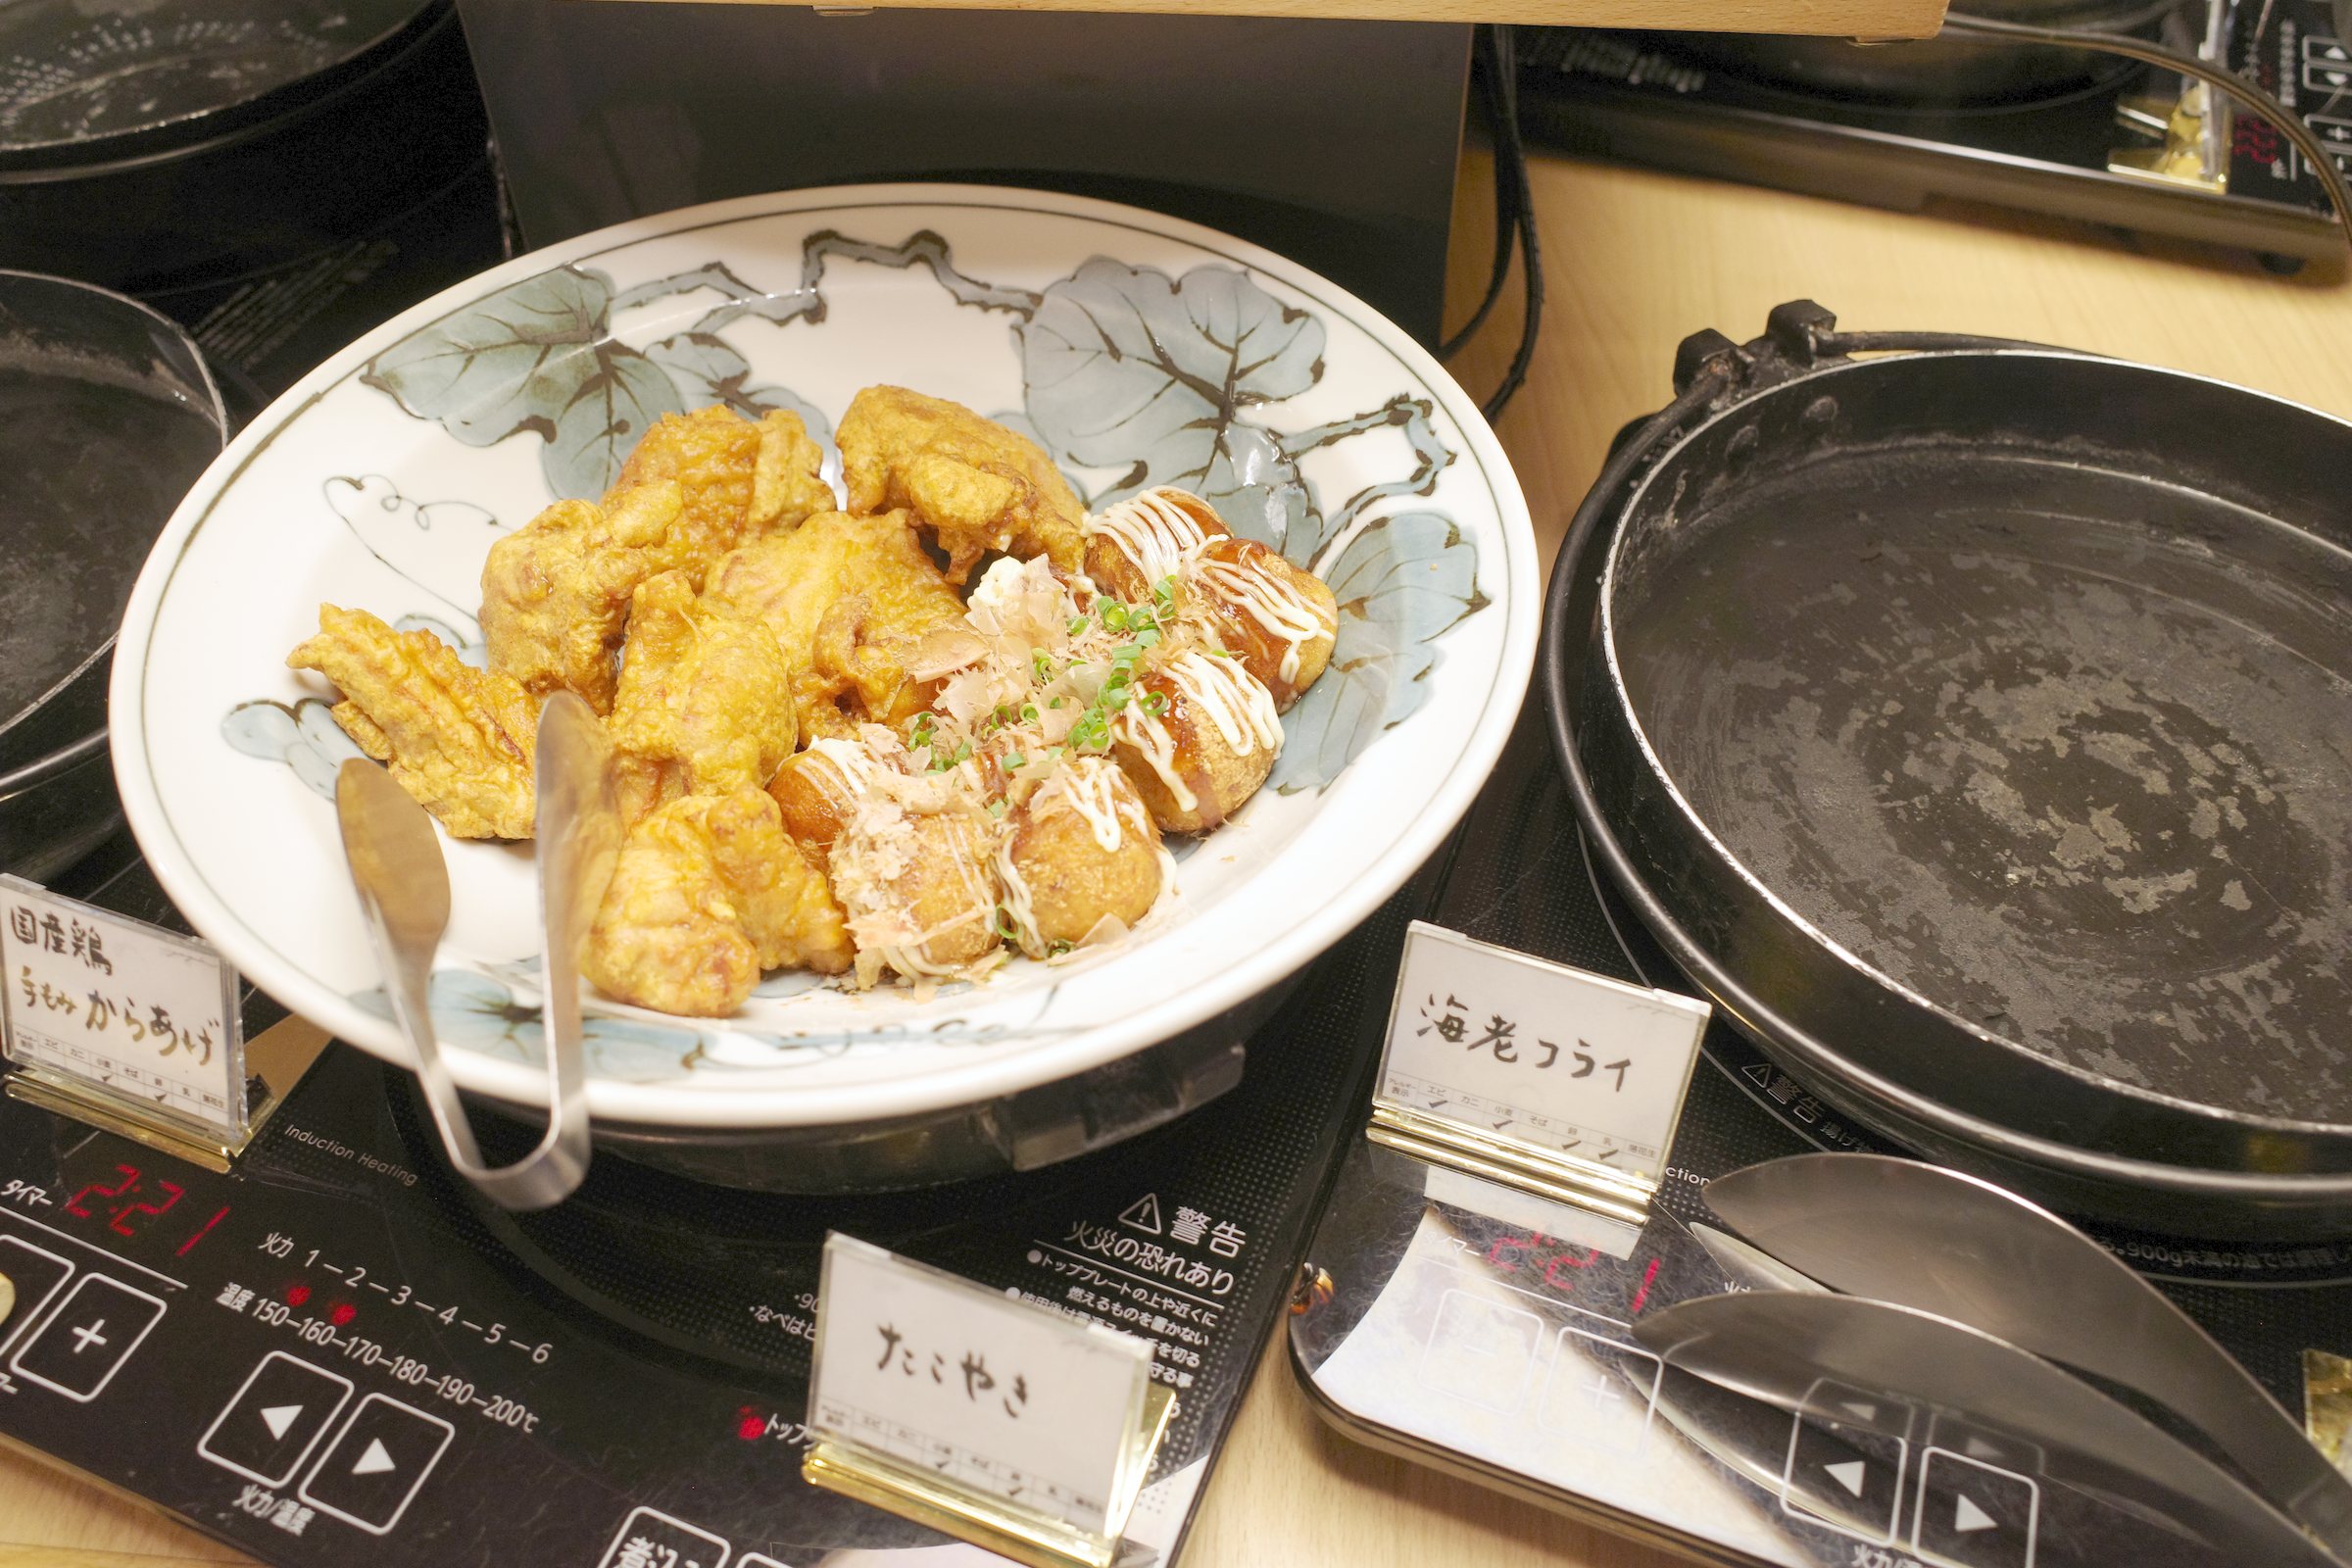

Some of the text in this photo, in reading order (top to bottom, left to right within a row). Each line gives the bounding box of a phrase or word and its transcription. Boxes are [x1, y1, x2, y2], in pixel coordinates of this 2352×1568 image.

[1416, 994, 1631, 1092] 海老フライ
[284, 1124, 417, 1187] Induction Heating
[0, 1179, 53, 1206] タイマー
[258, 1232, 294, 1258] 火力
[1063, 1220, 1235, 1295] 火災の恐れあり
[1169, 1205, 1247, 1259] 警告
[877, 1322, 1028, 1419] たこやき
